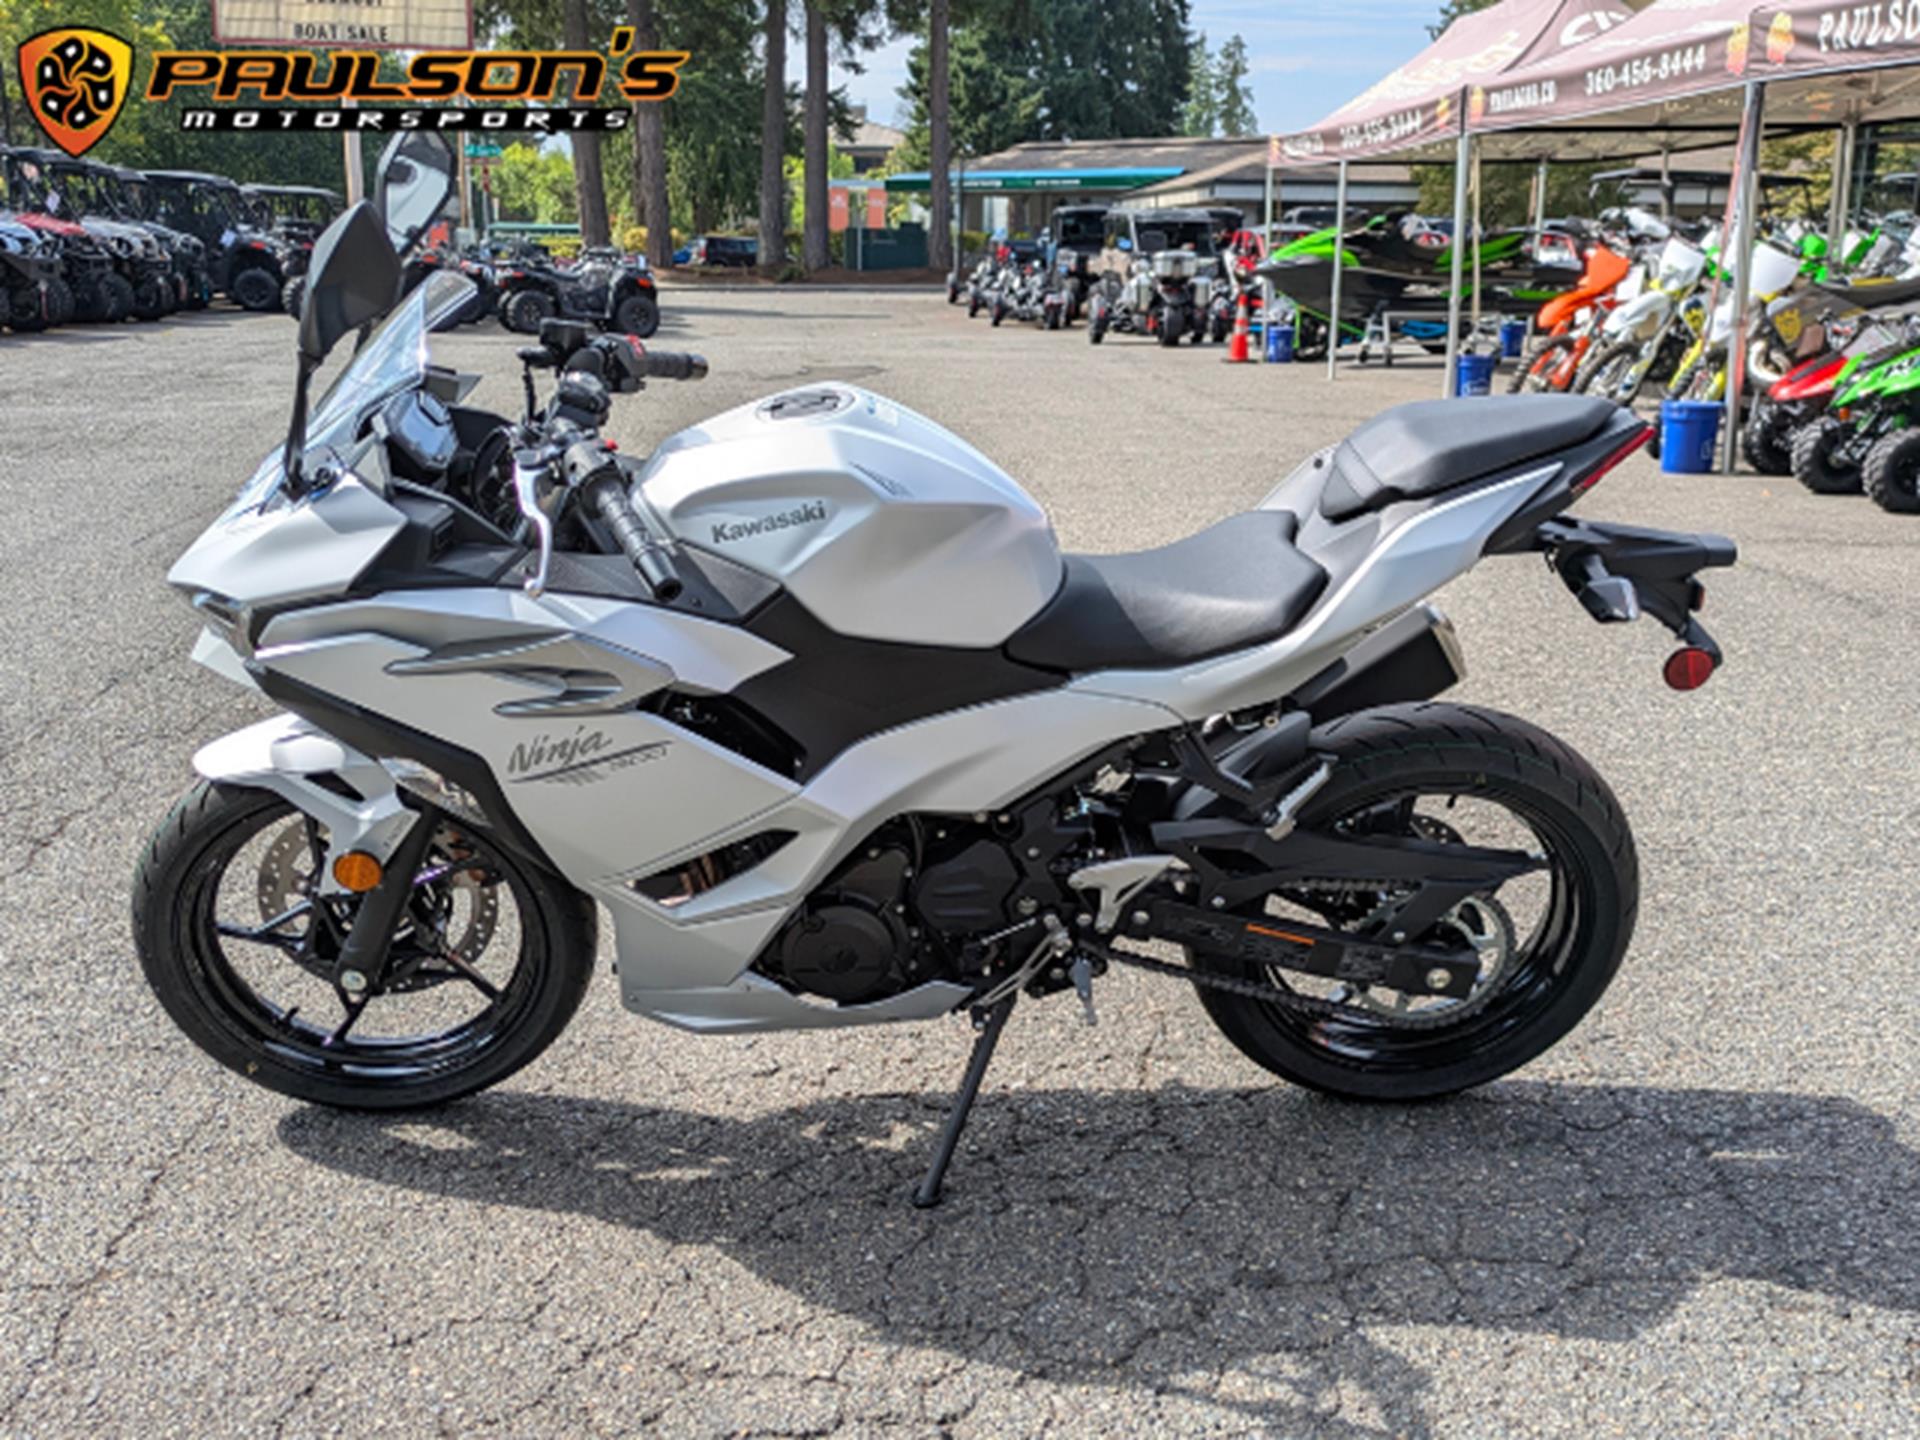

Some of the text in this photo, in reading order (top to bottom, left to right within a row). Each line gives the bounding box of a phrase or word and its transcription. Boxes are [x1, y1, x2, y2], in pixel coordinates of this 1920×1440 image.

[293, 23, 389, 42] BOAT SALE
[710, 500, 826, 543] Kawasaki
[507, 725, 613, 774] Ninja
